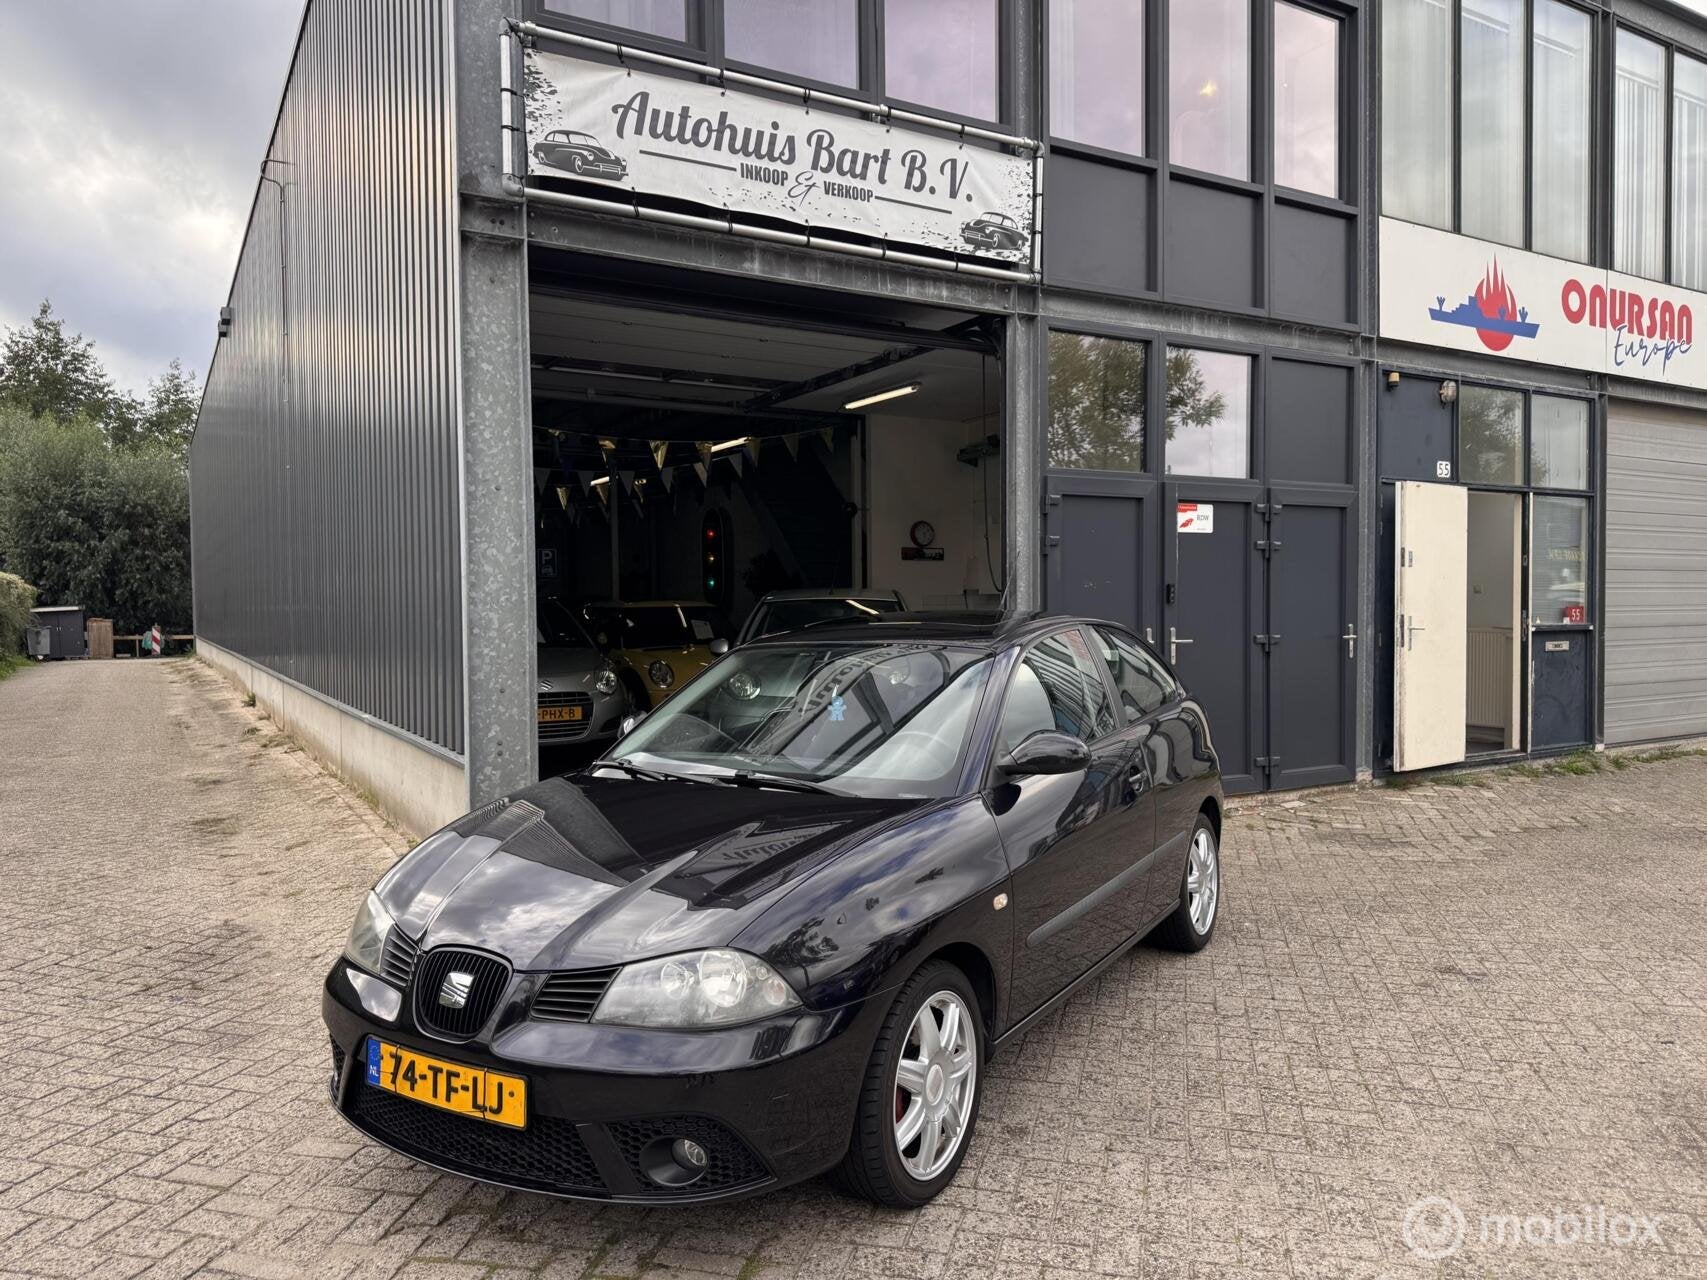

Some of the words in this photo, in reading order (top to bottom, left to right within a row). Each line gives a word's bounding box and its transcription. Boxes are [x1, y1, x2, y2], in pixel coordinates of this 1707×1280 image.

[611, 91, 797, 165] Autohuis
[806, 128, 892, 183] Bart
[900, 149, 974, 202] B.V.
[740, 163, 788, 187] INKOOP
[788, 171, 818, 207] &
[823, 180, 874, 203] VERKOOP
[1561, 278, 1693, 345] ONURSAN
[1614, 324, 1692, 376] Europe
[1438, 462, 1450, 476] 55
[1571, 608, 1581, 621] 55
[369, 1064, 379, 1078] NL
[390, 1051, 503, 1115] 74-TF-LJ
